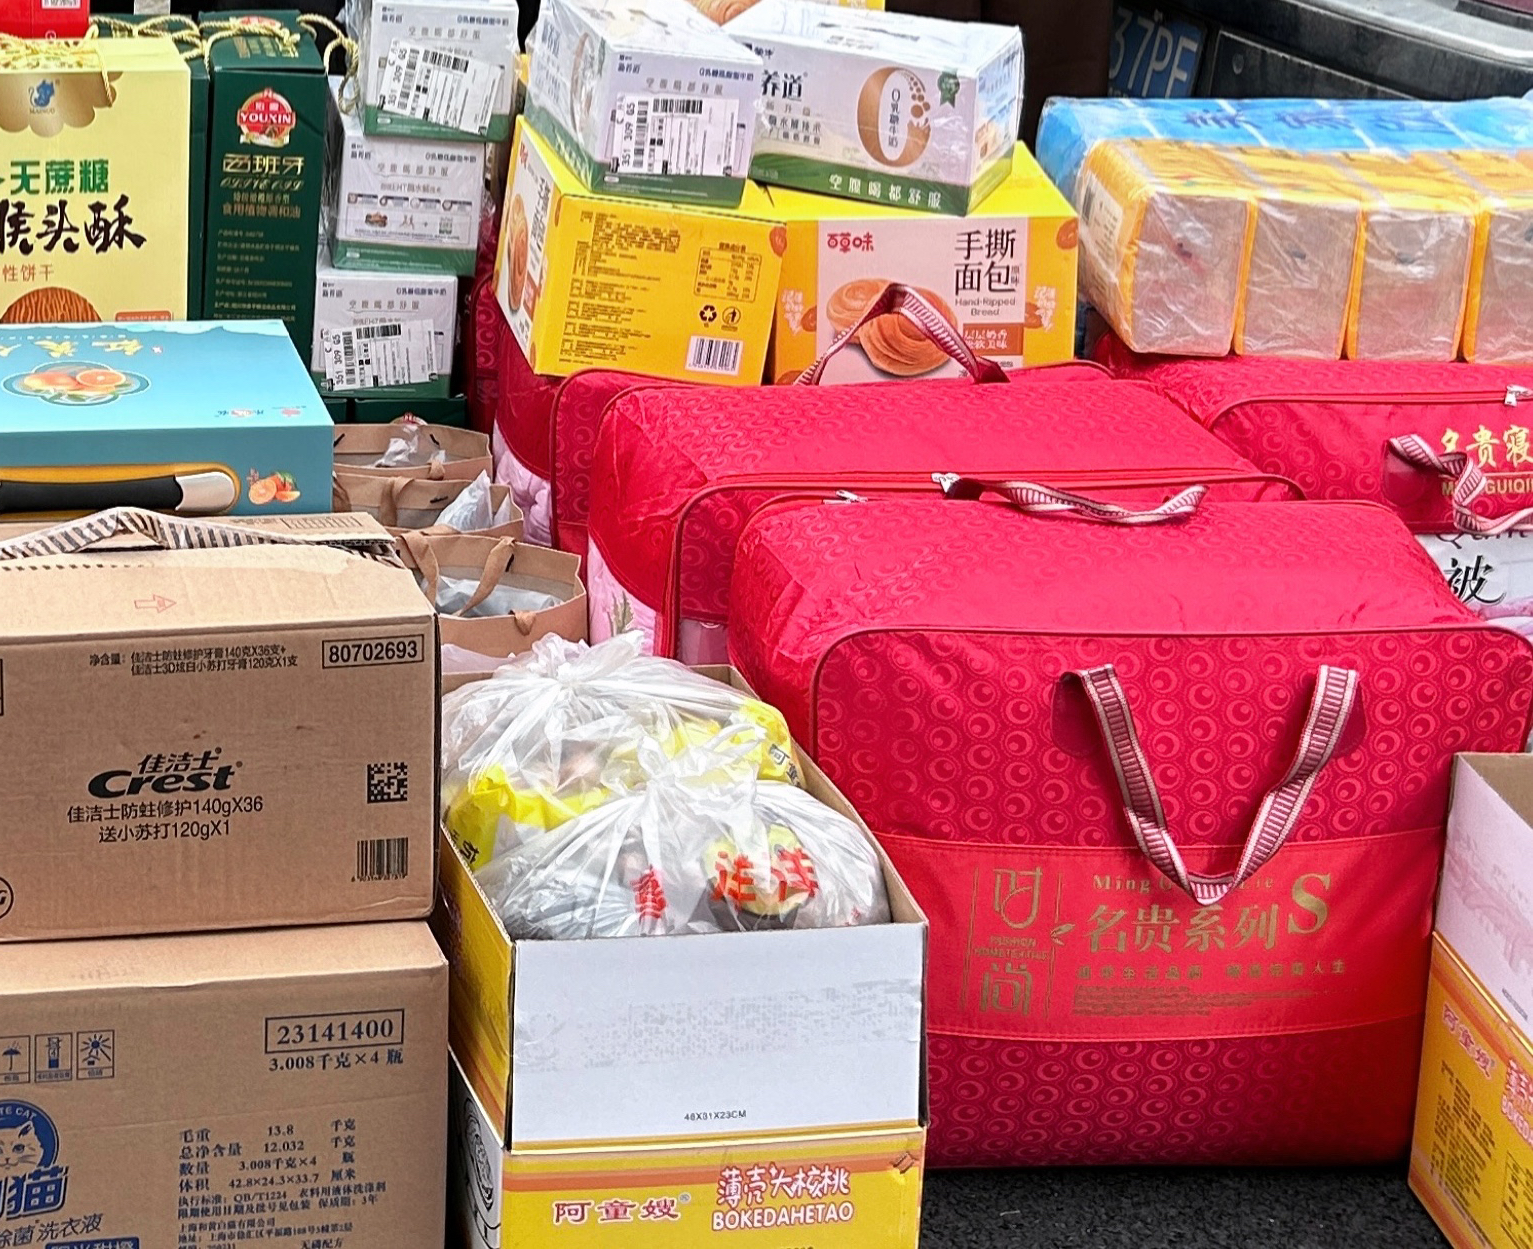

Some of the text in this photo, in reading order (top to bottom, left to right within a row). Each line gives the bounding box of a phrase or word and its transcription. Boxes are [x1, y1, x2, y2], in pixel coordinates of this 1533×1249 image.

[761, 69, 802, 100] 养道
[240, 112, 291, 125] YOUXIN
[9, 158, 110, 196] 无蔗糖
[223, 153, 304, 175] 西班牙
[829, 173, 942, 208] 空腹喝都舒服
[827, 232, 874, 253] 百草味
[955, 228, 1017, 262] 手撕
[954, 261, 1016, 296] 面包
[328, 640, 418, 664] 80702693
[137, 749, 217, 774] 佳洁士
[87, 764, 235, 799] Crest
[67, 795, 264, 823] 佳洁士防蛀修护140gX36
[98, 819, 231, 844] 送小苏打120gX1
[1093, 875, 1151, 894] Ming
[1084, 872, 1332, 953] 名贵系列 S
[979, 962, 1033, 1017] 尚
[277, 1018, 393, 1045] 23141400
[15, 1107, 38, 1120] CAT
[180, 1118, 356, 1143] 毛重 13.8 千克
[179, 1135, 355, 1160] 总净含量 12.032 千克
[179, 1161, 210, 1176] 数量
[179, 1178, 210, 1193] 体积
[331, 1169, 356, 1182] 厘米
[554, 1198, 680, 1225] 阿童嫂
[711, 1201, 855, 1231] BOKEDAHETAO
